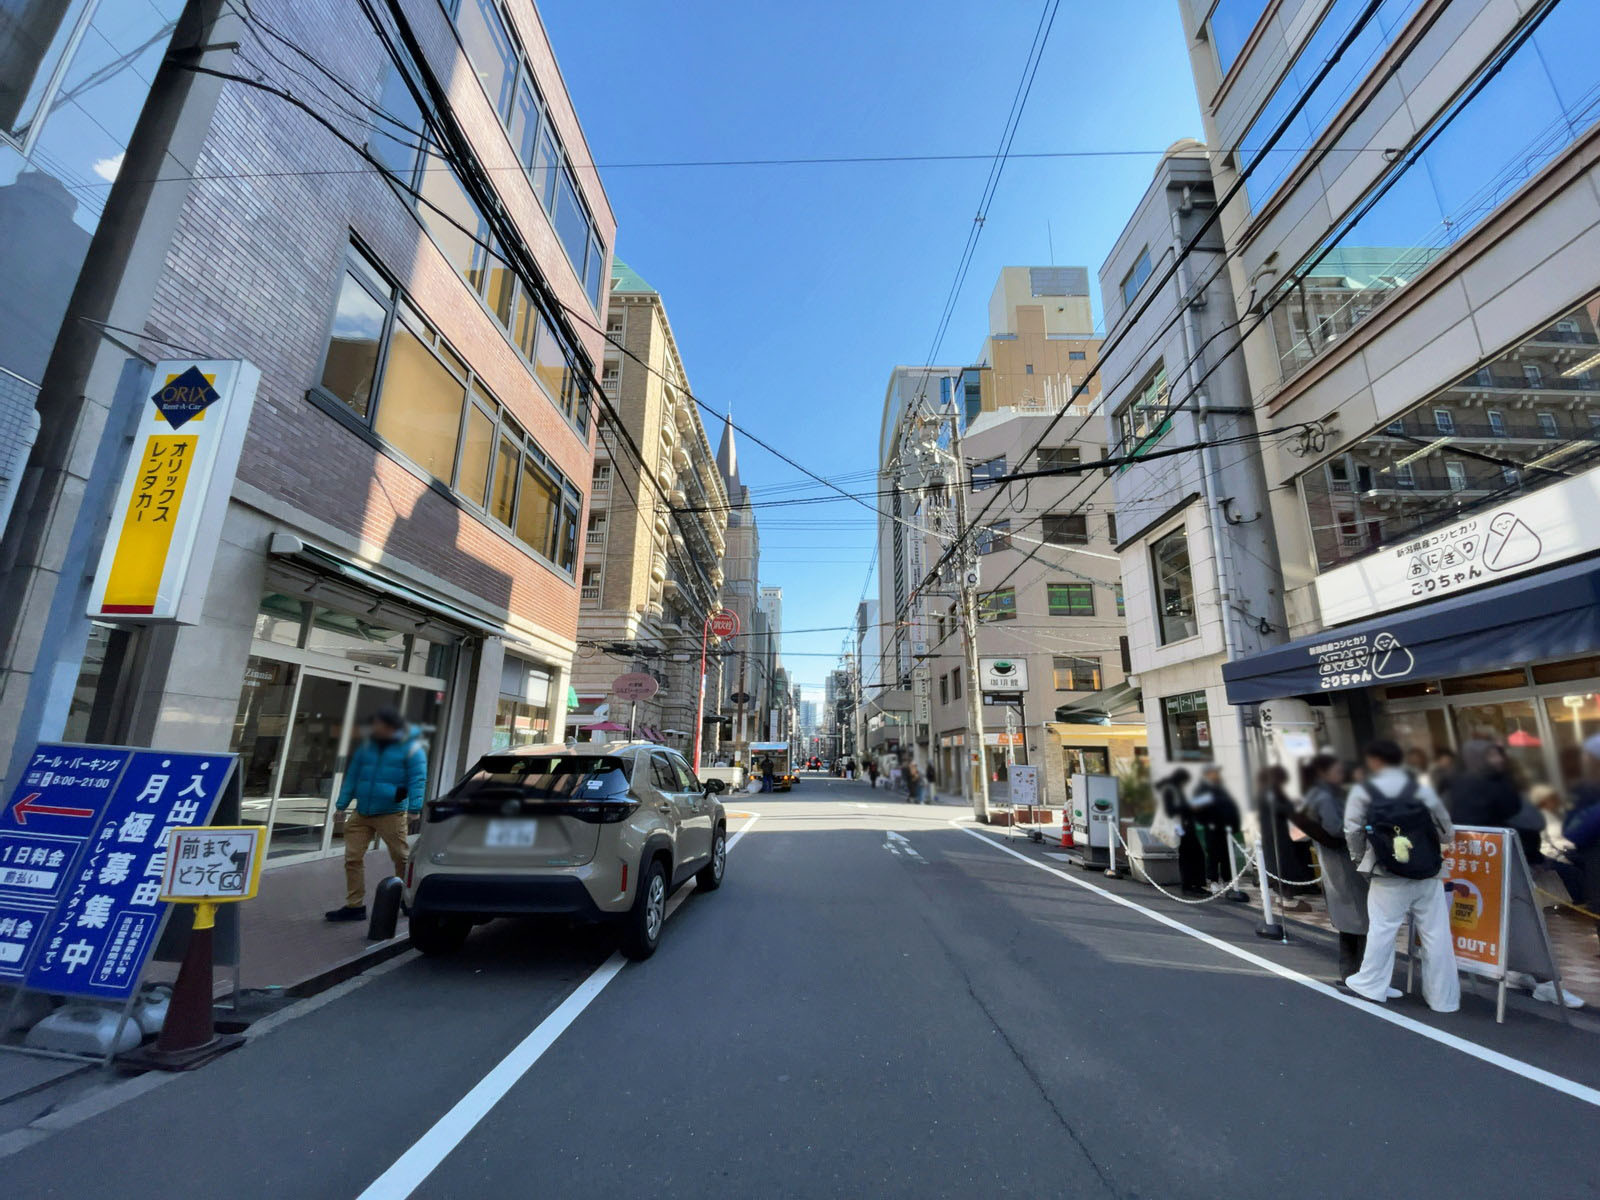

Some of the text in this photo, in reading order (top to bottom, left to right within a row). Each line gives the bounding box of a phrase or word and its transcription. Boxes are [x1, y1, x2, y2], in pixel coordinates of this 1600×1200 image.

[162, 386, 210, 402] ORIX
[136, 442, 168, 522] レンタカー
[152, 442, 188, 522] オリックス
[1396, 521, 1477, 558] 新潟県産コシヒカリ
[1411, 541, 1474, 575] おにぎり
[1411, 565, 1482, 596] ごりちゃん
[1321, 669, 1372, 689] ごりちゃん
[2, 845, 66, 868] 1日料金
[182, 837, 231, 859] 前まで
